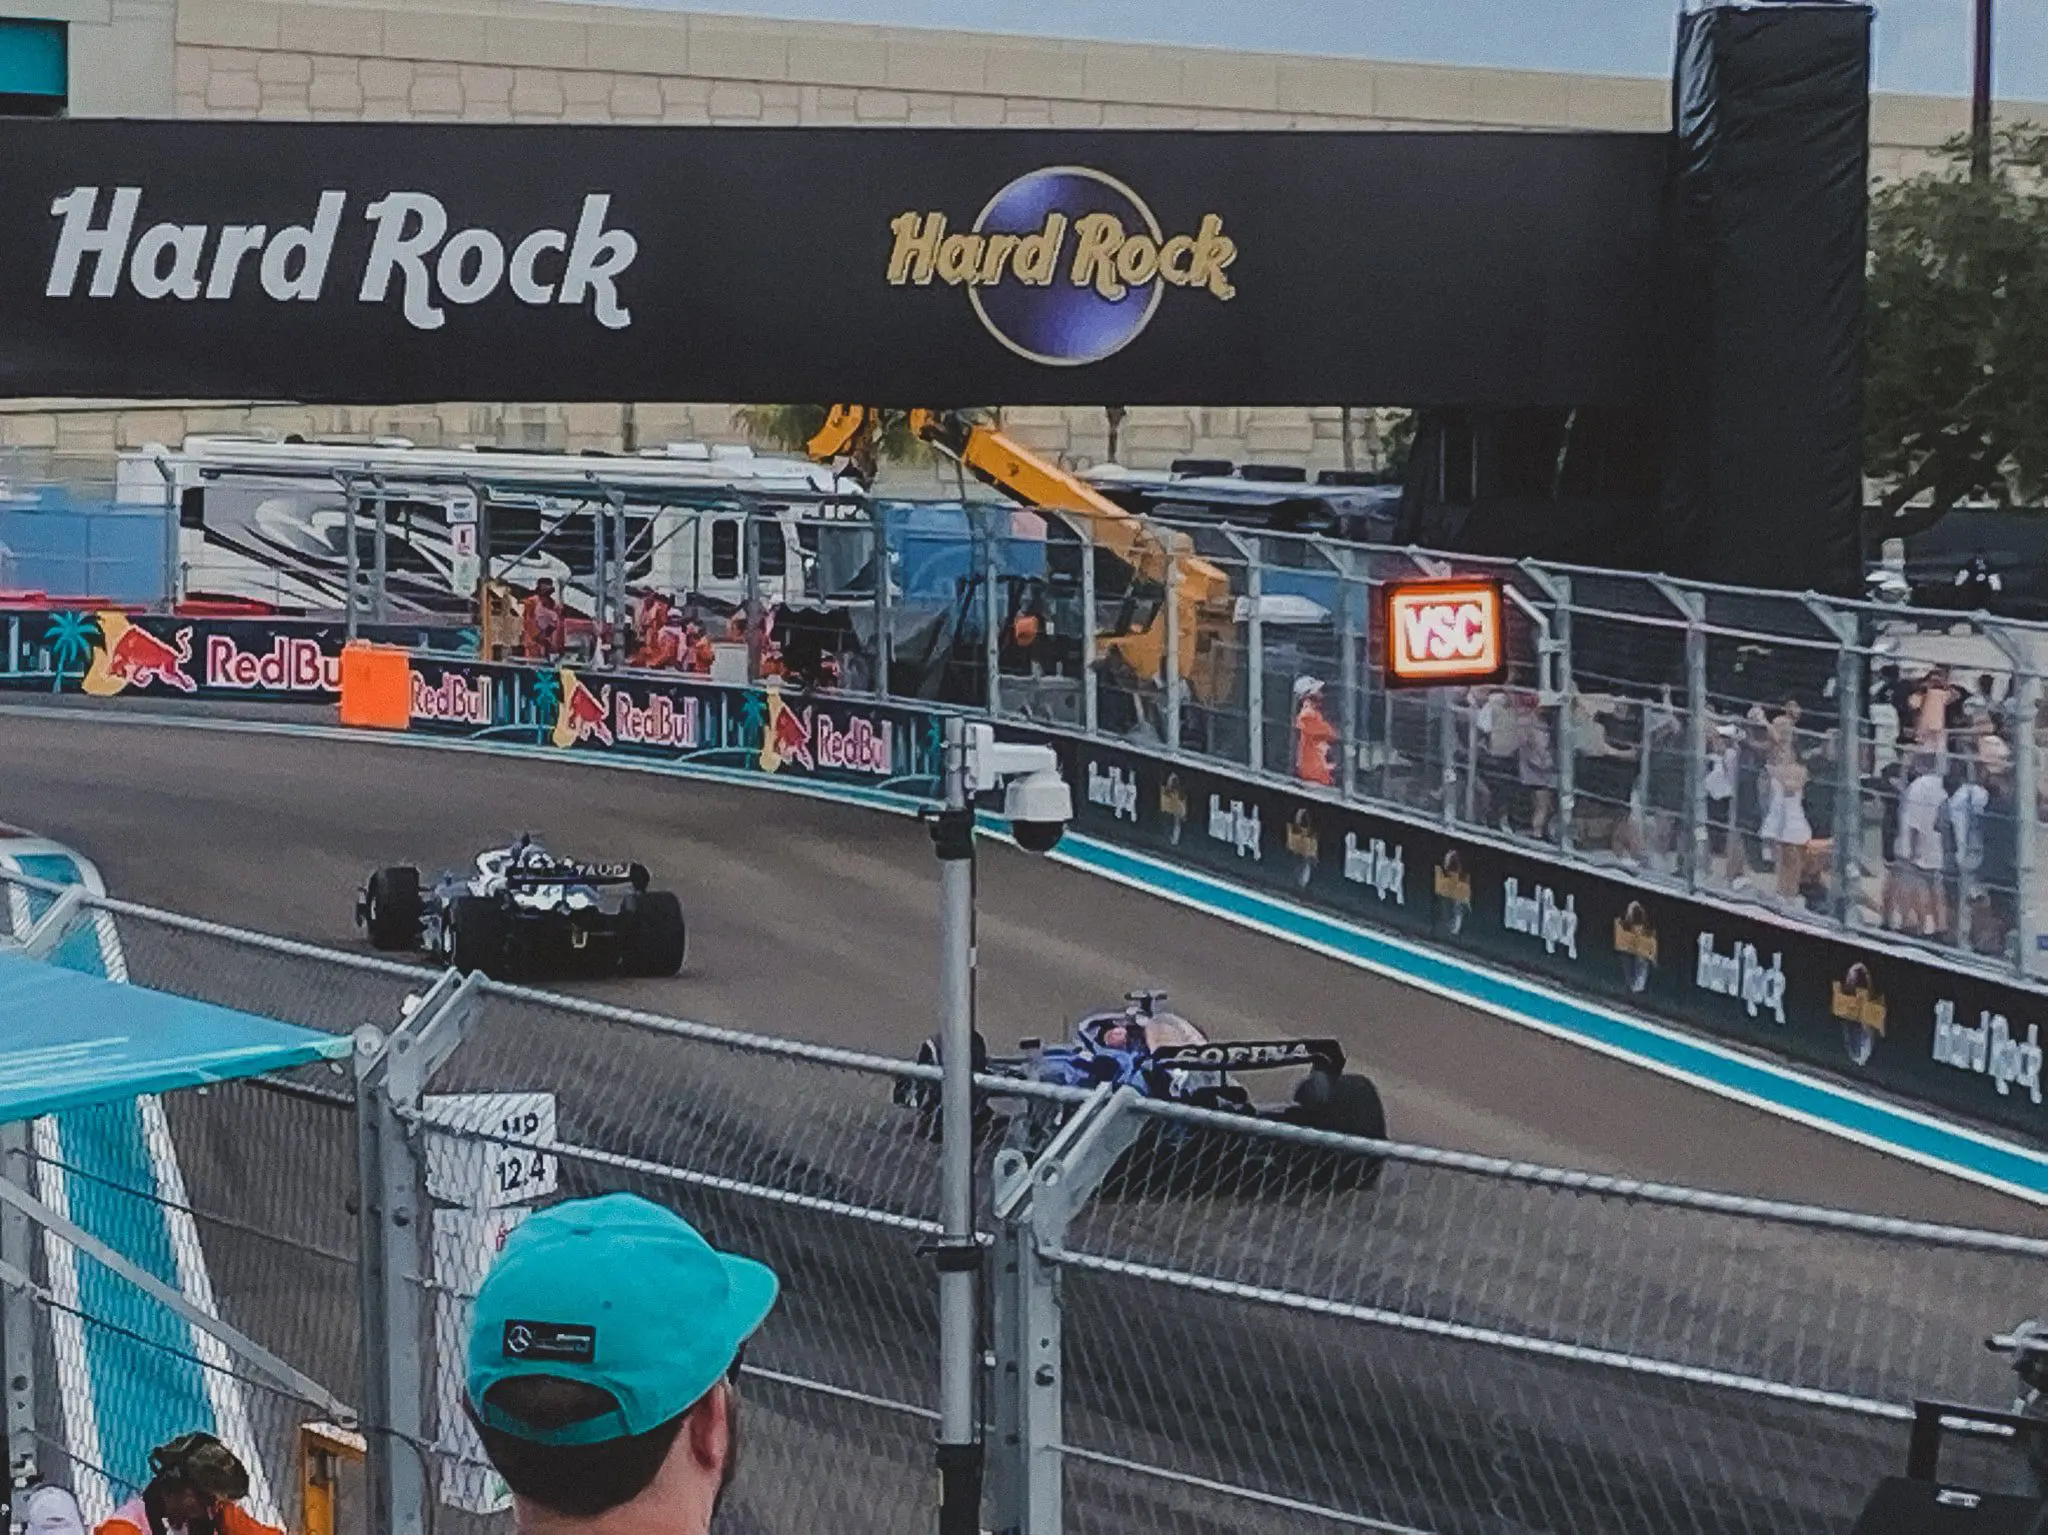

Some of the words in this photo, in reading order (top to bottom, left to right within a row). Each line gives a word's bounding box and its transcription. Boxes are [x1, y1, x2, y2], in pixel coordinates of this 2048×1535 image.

[45, 186, 346, 301] Hard
[358, 191, 638, 329] Rock
[887, 211, 1068, 286] Hard
[1070, 212, 1238, 301] Rock
[1403, 602, 1484, 659] VSC
